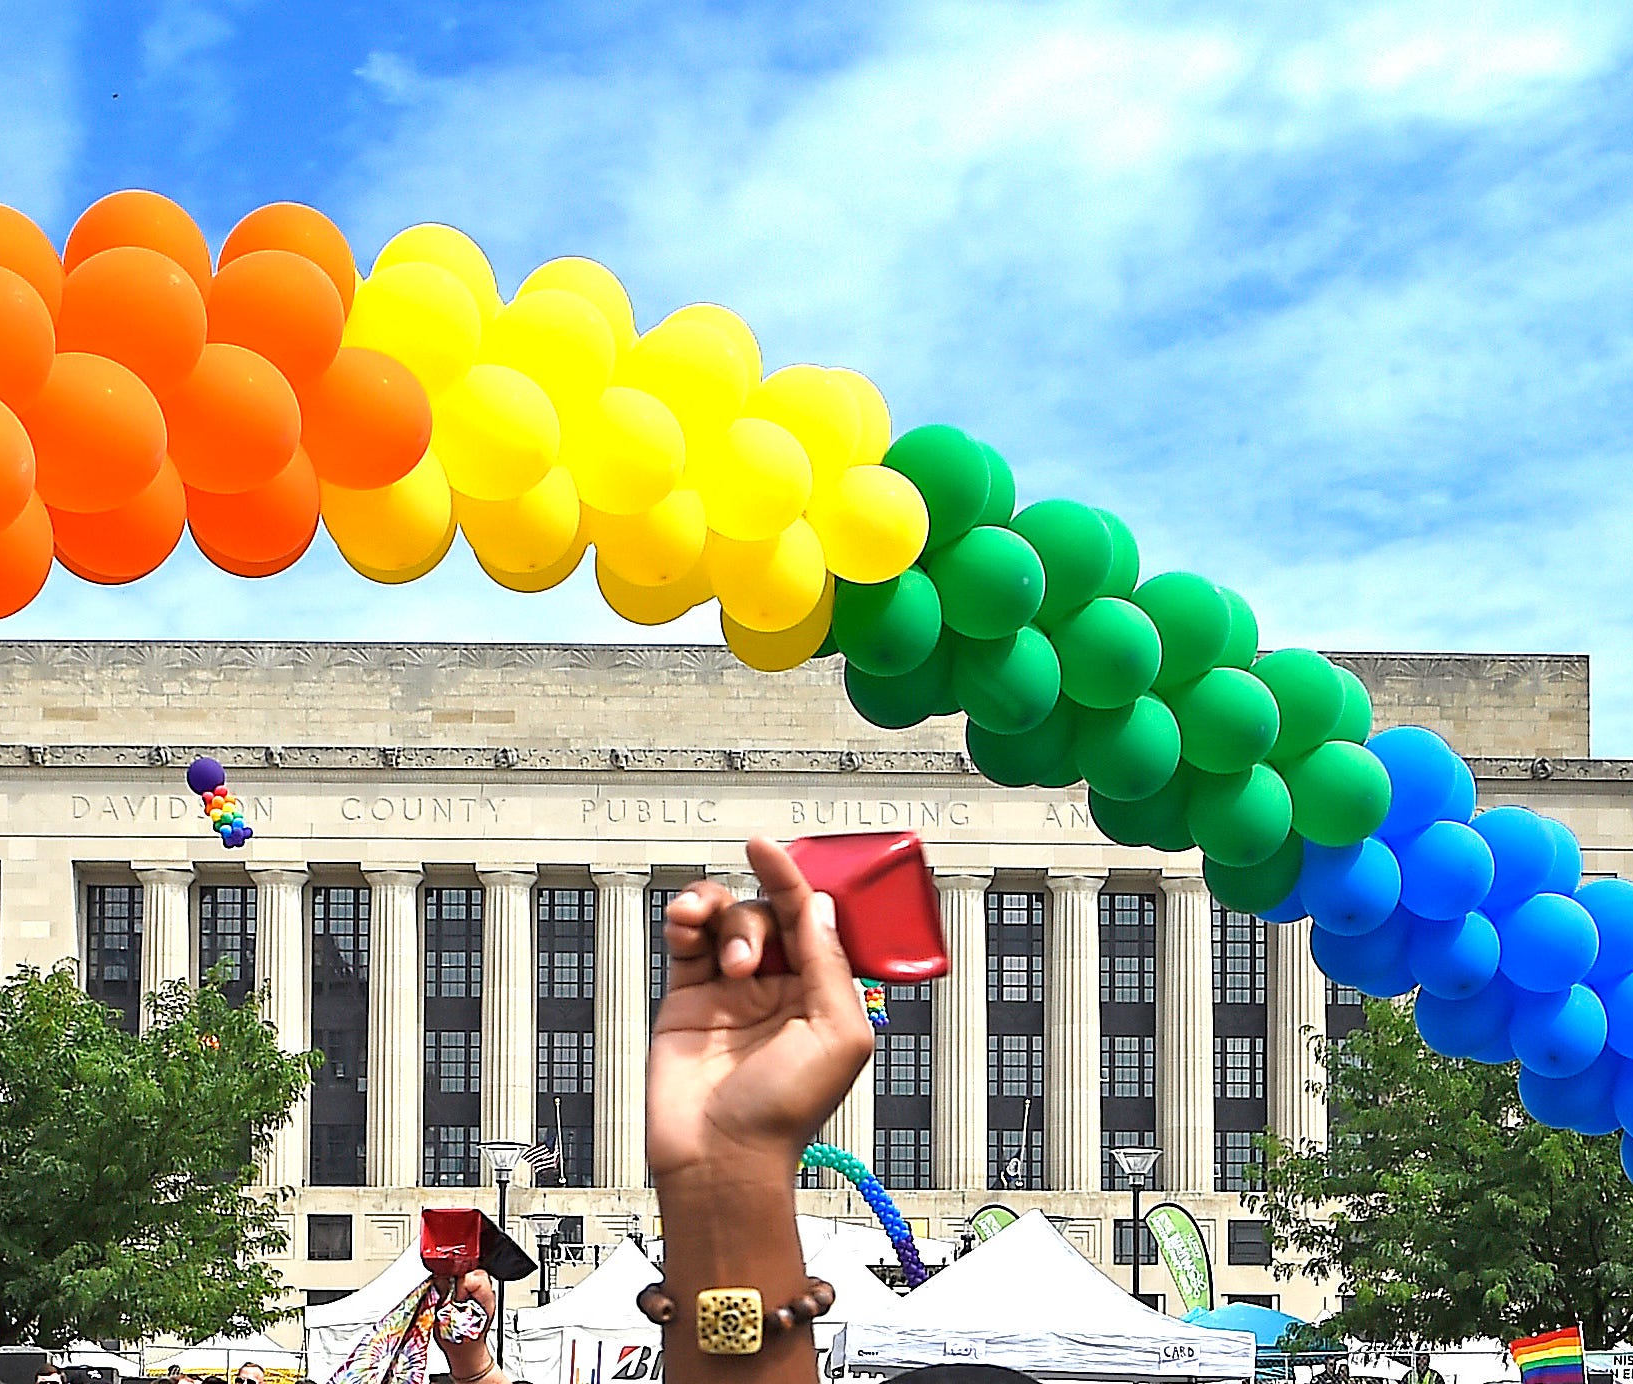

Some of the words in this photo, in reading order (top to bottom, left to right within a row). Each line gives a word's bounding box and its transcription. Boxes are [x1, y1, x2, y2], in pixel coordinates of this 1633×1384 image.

[341, 797, 507, 823] COUNTY
[580, 799, 718, 825] PUBLIC
[790, 801, 971, 827] BUILDING
[1042, 803, 1089, 828] AN
[1163, 1345, 1196, 1359] CARD
